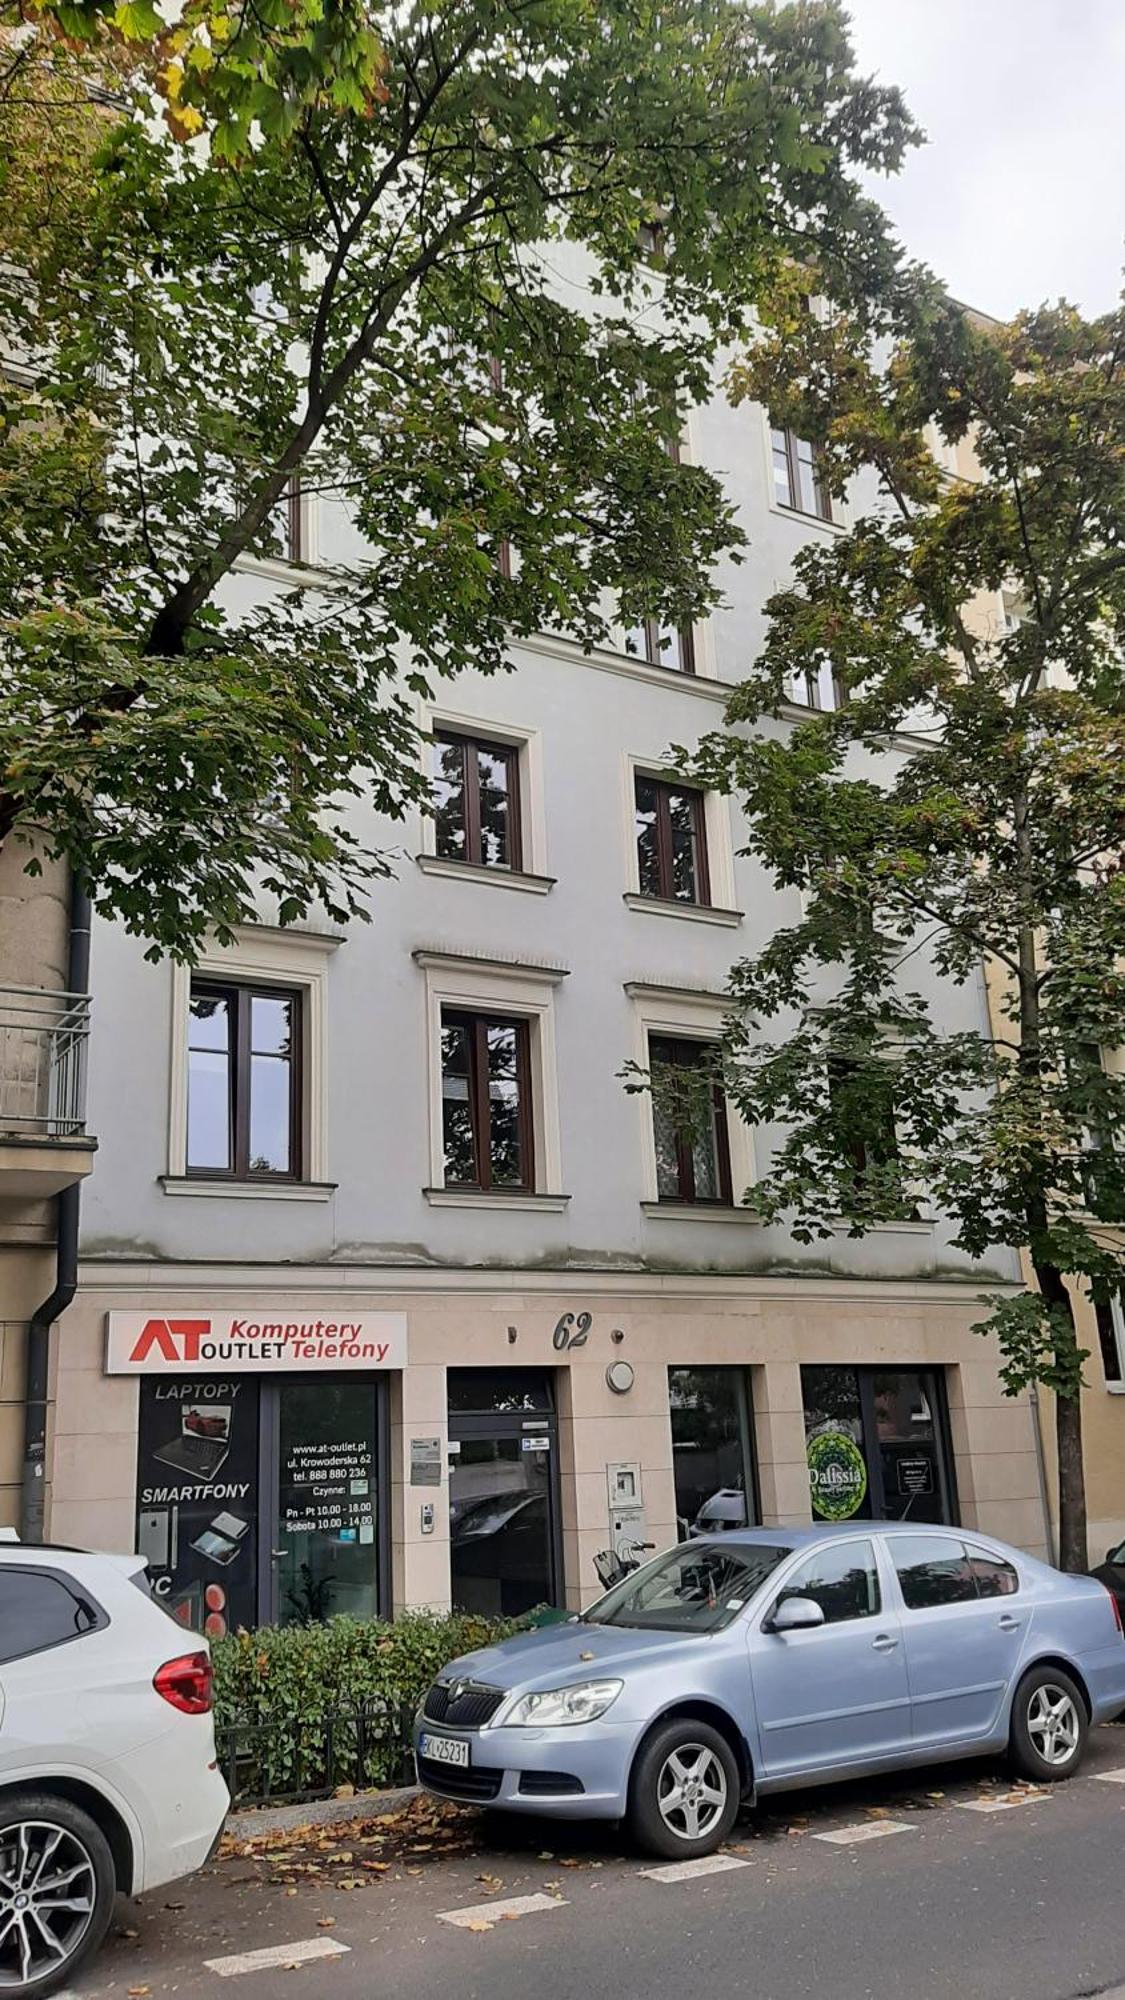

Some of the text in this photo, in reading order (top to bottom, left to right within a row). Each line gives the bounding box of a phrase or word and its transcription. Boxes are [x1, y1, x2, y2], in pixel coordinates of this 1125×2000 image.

[230, 1321, 362, 1342] Komputery
[553, 1312, 592, 1351] 62
[201, 1343, 286, 1360] OUTLET
[291, 1340, 390, 1361] Telefony
[155, 1383, 241, 1399] LAPTOPY
[293, 1441, 366, 1454] www.at-outlet.pl
[287, 1454, 372, 1468] ul. Krowoderska 62
[293, 1467, 366, 1481] tel. 888 880 236
[141, 1483, 250, 1503] SMARTFONY
[312, 1486, 346, 1497] Czynne:
[286, 1508, 298, 1518] Pn
[305, 1506, 316, 1516] Pt
[317, 1505, 341, 1515] 10.00
[348, 1502, 372, 1513] 18.00
[286, 1520, 316, 1532] Sobota
[318, 1518, 342, 1529] 10.00
